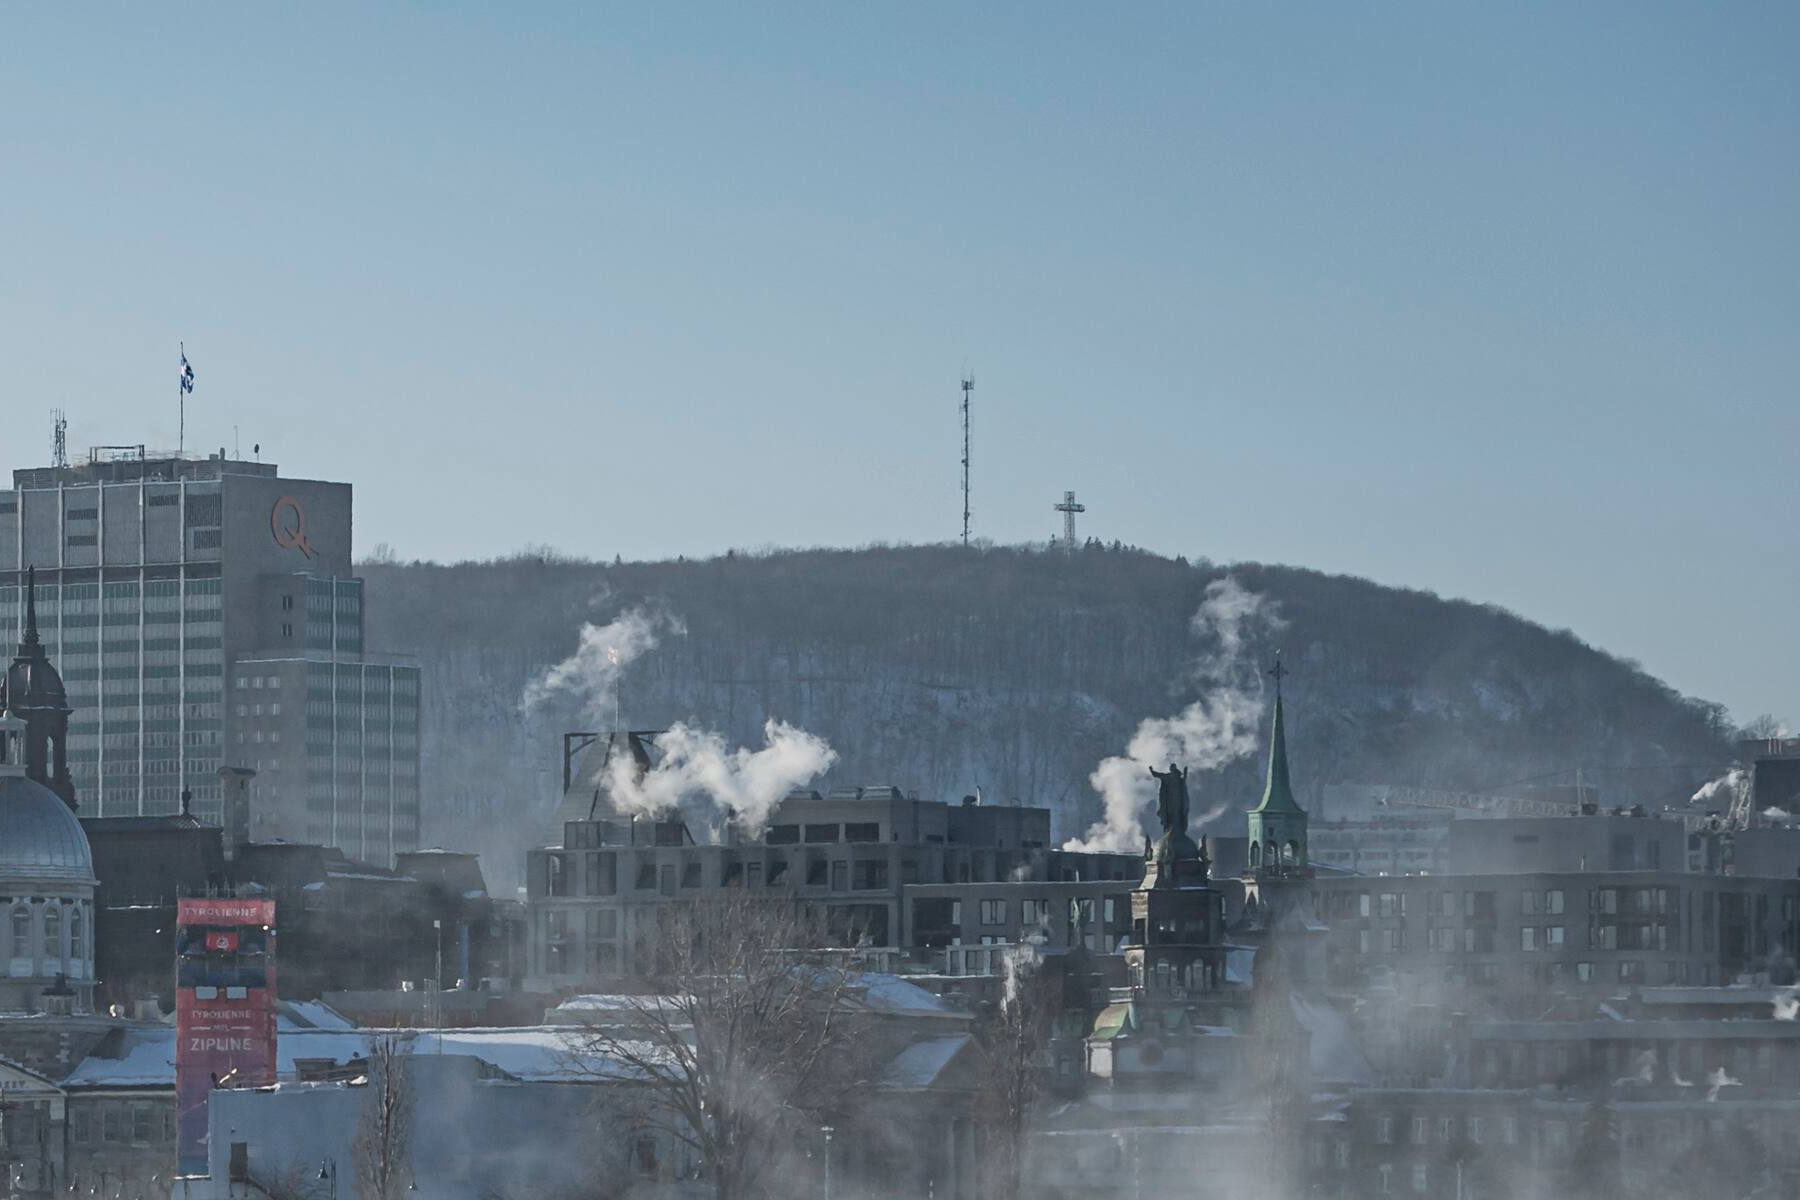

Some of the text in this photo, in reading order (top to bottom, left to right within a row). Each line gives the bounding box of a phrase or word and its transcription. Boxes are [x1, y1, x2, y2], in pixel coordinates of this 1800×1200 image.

[271, 495, 319, 560] Q
[184, 907, 257, 917] TYROLIENNE
[192, 1010, 251, 1019] TYROLIENNE
[190, 1038, 252, 1051] ZIPLINE
